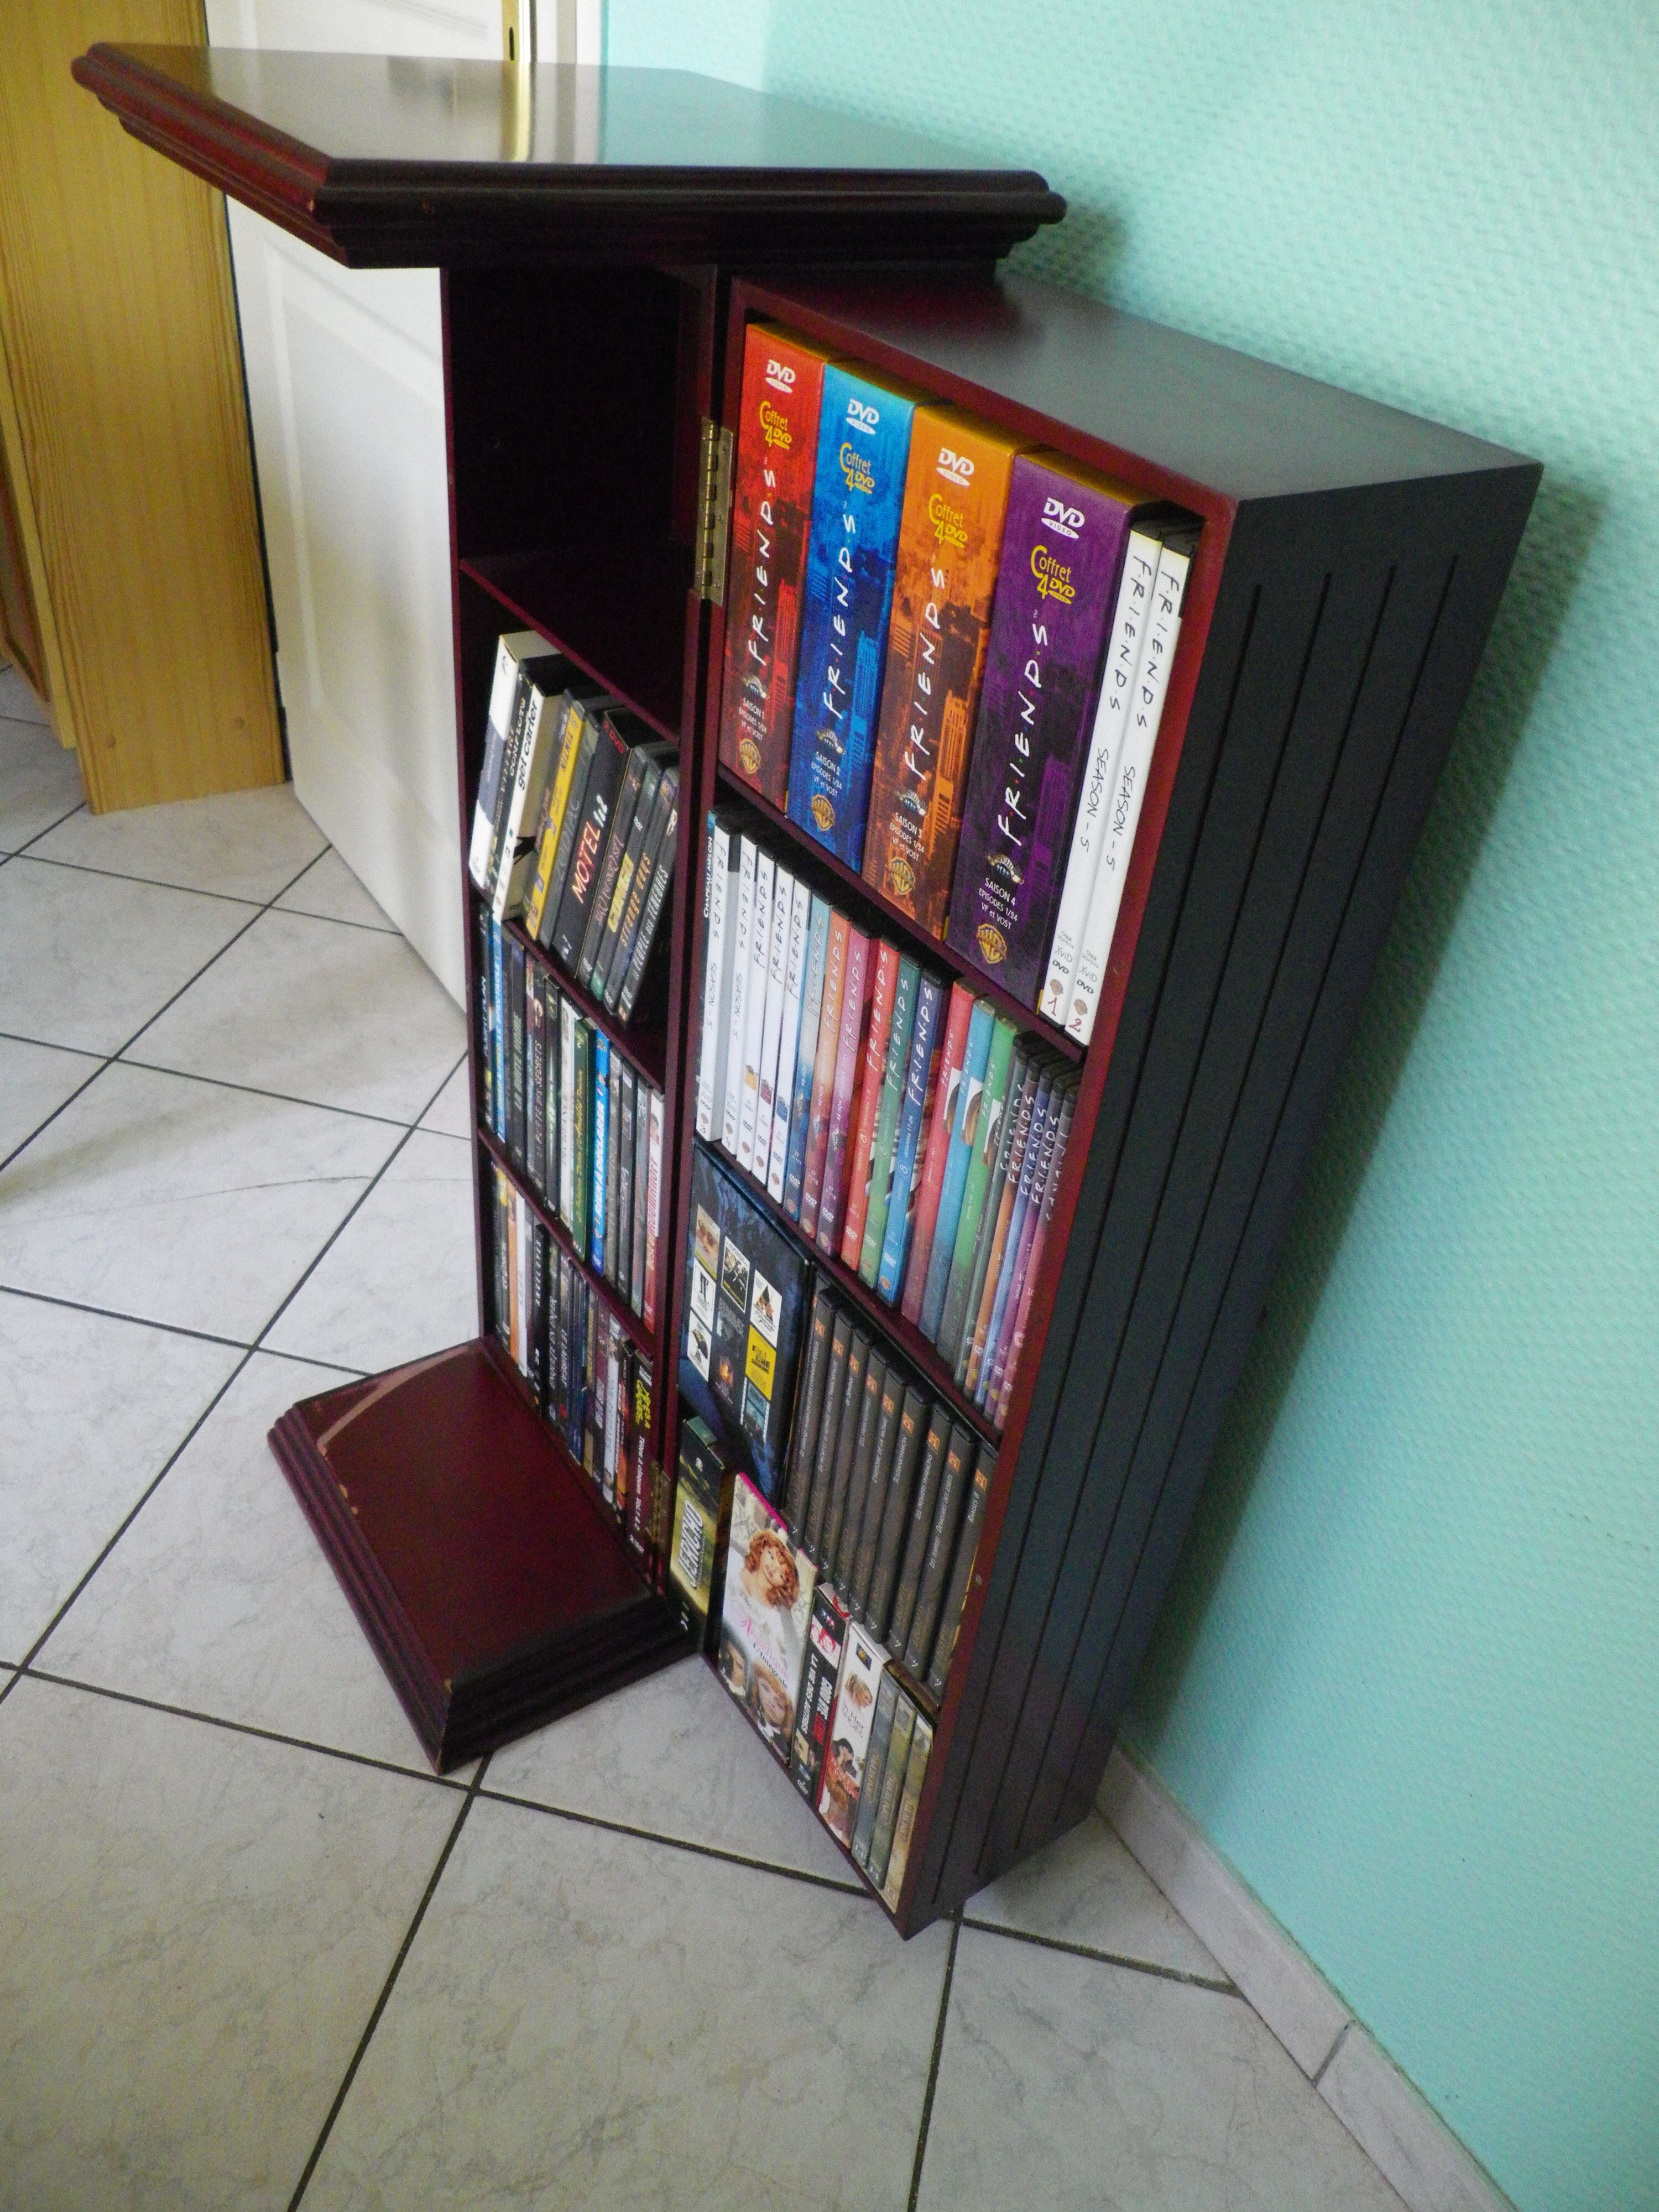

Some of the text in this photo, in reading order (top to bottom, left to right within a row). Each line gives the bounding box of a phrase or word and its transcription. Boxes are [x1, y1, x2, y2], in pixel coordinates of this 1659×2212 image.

[766, 359, 795, 383] DVD
[759, 400, 788, 431] Coffret
[847, 398, 879, 424] DVD
[839, 442, 870, 474] Coffret
[938, 448, 974, 476] DVD
[928, 494, 963, 528] Coffret
[1044, 497, 1084, 528] DVD
[1049, 521, 1072, 536] VIDEO
[1031, 545, 1071, 582] Coffret
[743, 698, 759, 716] SAISON
[739, 708, 767, 734] EPISODES 1/24
[519, 700, 539, 791] get carter
[752, 729, 763, 741] VOST
[816, 752, 834, 771] SAISON
[811, 761, 843, 790] EPISODES 1/24
[1088, 748, 1109, 817] SEASON
[826, 784, 838, 797] VOST
[1113, 766, 1135, 836] SEASON
[895, 812, 917, 834] SAISON
[890, 822, 925, 853] EPISODES 1/24
[571, 821, 602, 905] MOTEL
[906, 848, 919, 861] VOST
[619, 890, 640, 947] strange
[636, 852, 651, 890] days
[704, 872, 712, 918] CHAPEAU
[985, 878, 1010, 902] SAISON
[979, 889, 1018, 921] EPISODES 1/24
[997, 915, 1011, 930] VOST
[633, 931, 651, 975] PEUPLE
[1055, 946, 1073, 962] XviD
[1052, 959, 1069, 974] DVD
[1078, 966, 1098, 983] XviD
[1077, 979, 1094, 994] DVD
[1047, 997, 1057, 1016] 1
[1068, 1018, 1082, 1033] 2
[789, 1173, 800, 1185] DVD
[806, 1192, 817, 1204] DVD
[823, 1207, 834, 1219] DVD
[846, 1225, 857, 1238] DVD
[921, 1453, 935, 1484] PHARAONS
[679, 1500, 703, 1588] JERICHO
[811, 1653, 818, 1668] LA
[817, 1677, 832, 1720] GOOD BYE
[801, 1699, 811, 1734] AUTRES
[851, 1711, 865, 1730] Her
